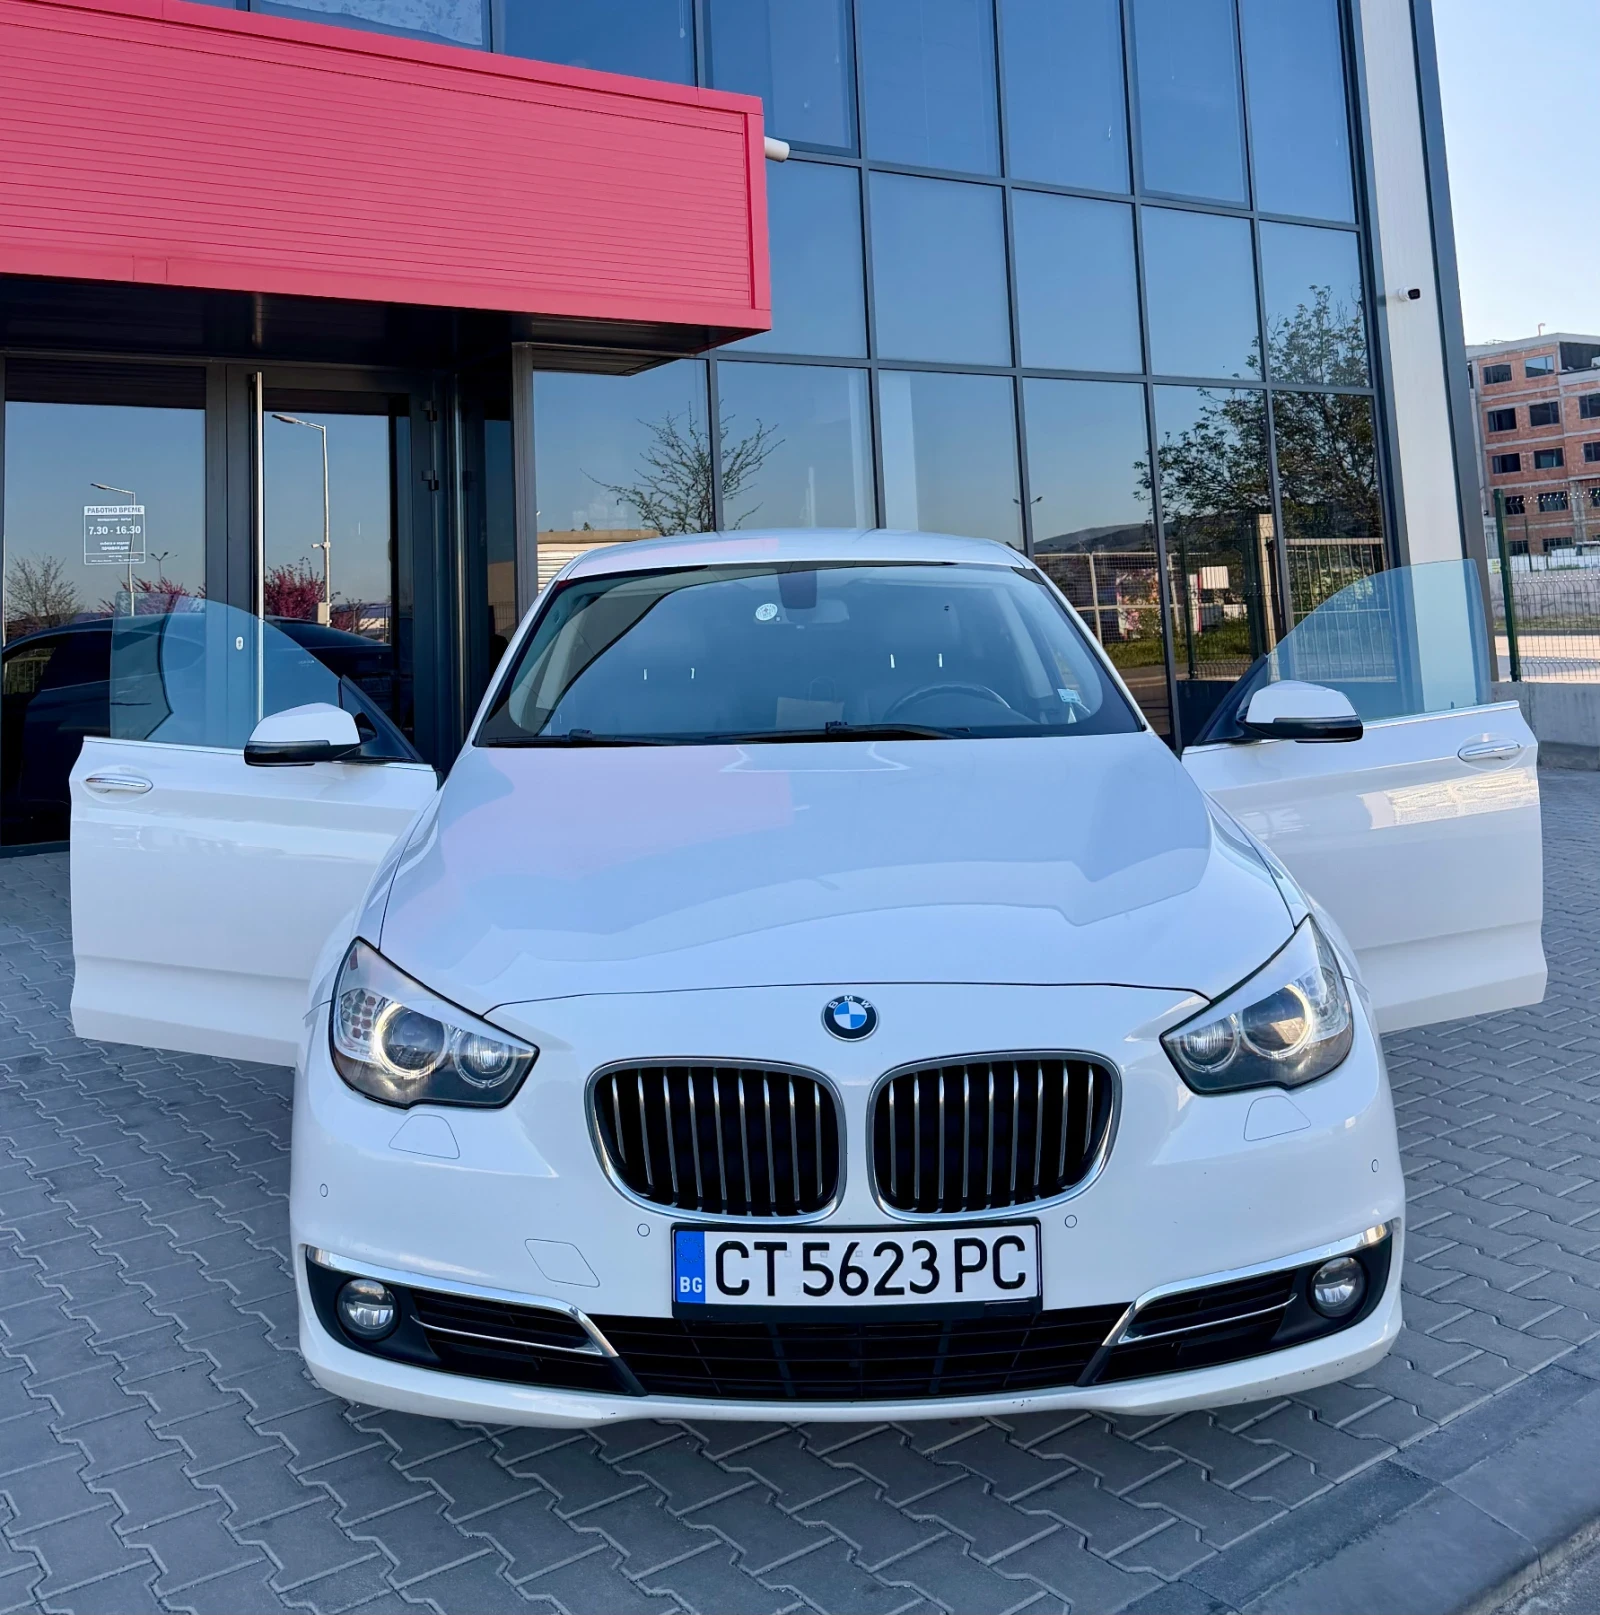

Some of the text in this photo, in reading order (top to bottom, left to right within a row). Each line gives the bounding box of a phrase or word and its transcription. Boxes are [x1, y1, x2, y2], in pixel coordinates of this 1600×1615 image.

[88, 526, 108, 535] 7.30
[116, 525, 141, 535] 16.30
[828, 995, 872, 1009] BMW
[680, 1276, 702, 1293] BG
